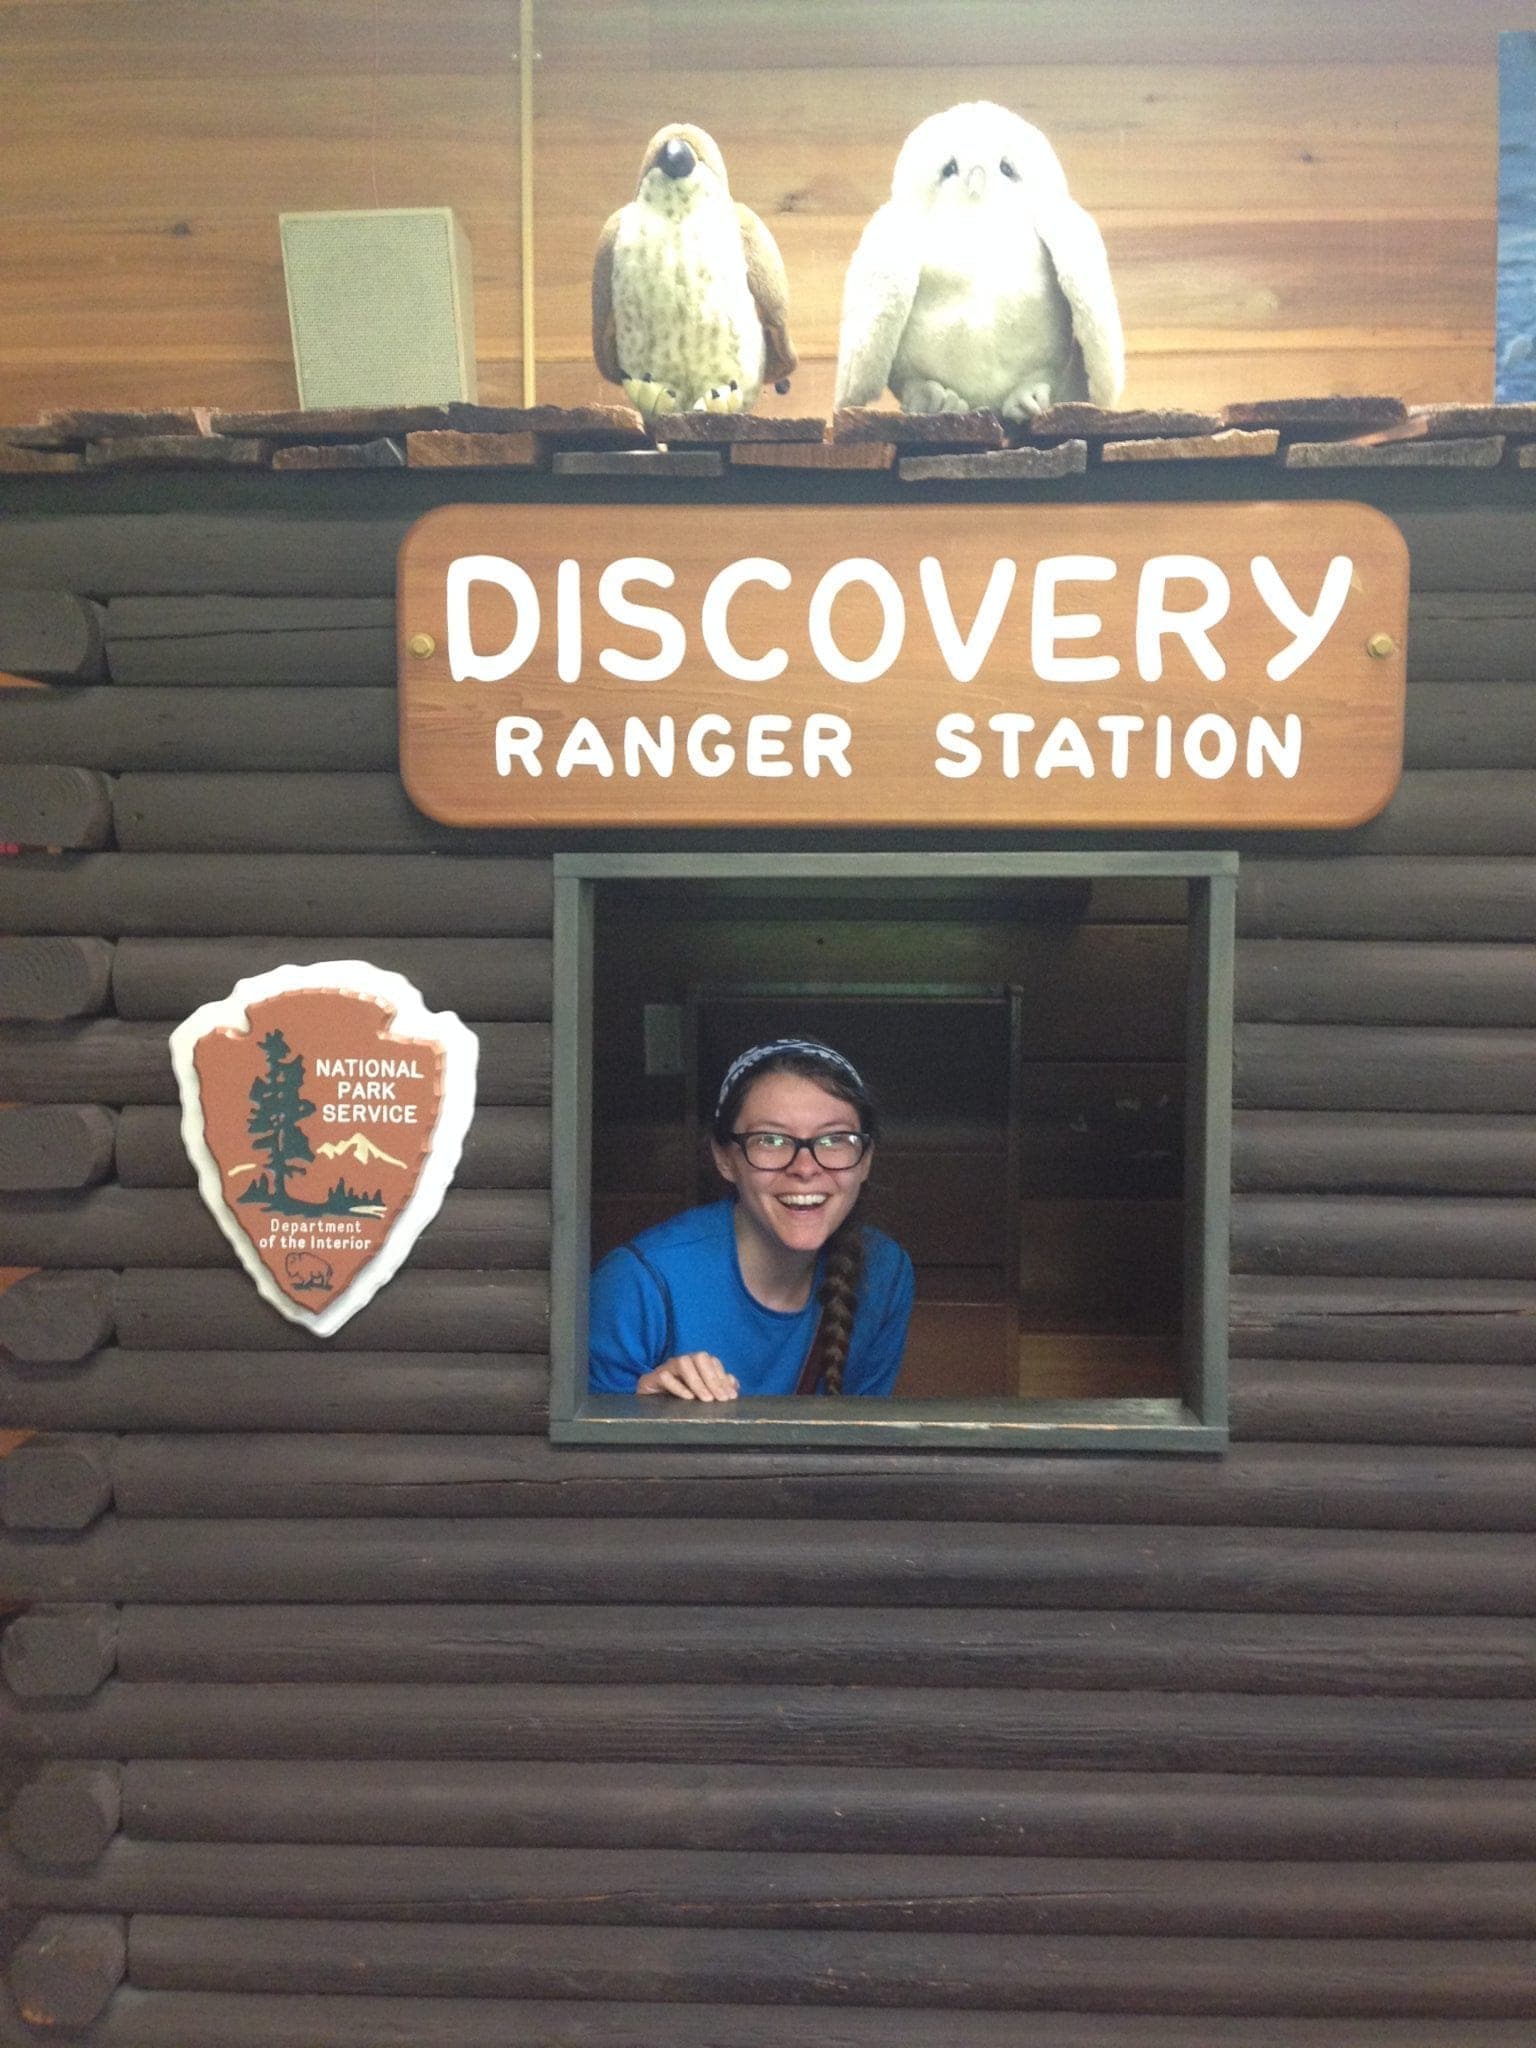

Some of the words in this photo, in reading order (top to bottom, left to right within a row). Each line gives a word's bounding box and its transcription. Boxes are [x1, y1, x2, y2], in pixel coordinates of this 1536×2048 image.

[446, 554, 1354, 684] DISCOVERY
[496, 714, 853, 778] RANGER
[934, 712, 1302, 779] STATION
[316, 1059, 424, 1079] NATIONAL
[337, 1081, 396, 1100] PARK
[322, 1105, 417, 1124] SERVICE
[271, 1219, 362, 1235] Department
[259, 1236, 277, 1249] of
[280, 1234, 306, 1249] the
[310, 1235, 371, 1249] Interior
